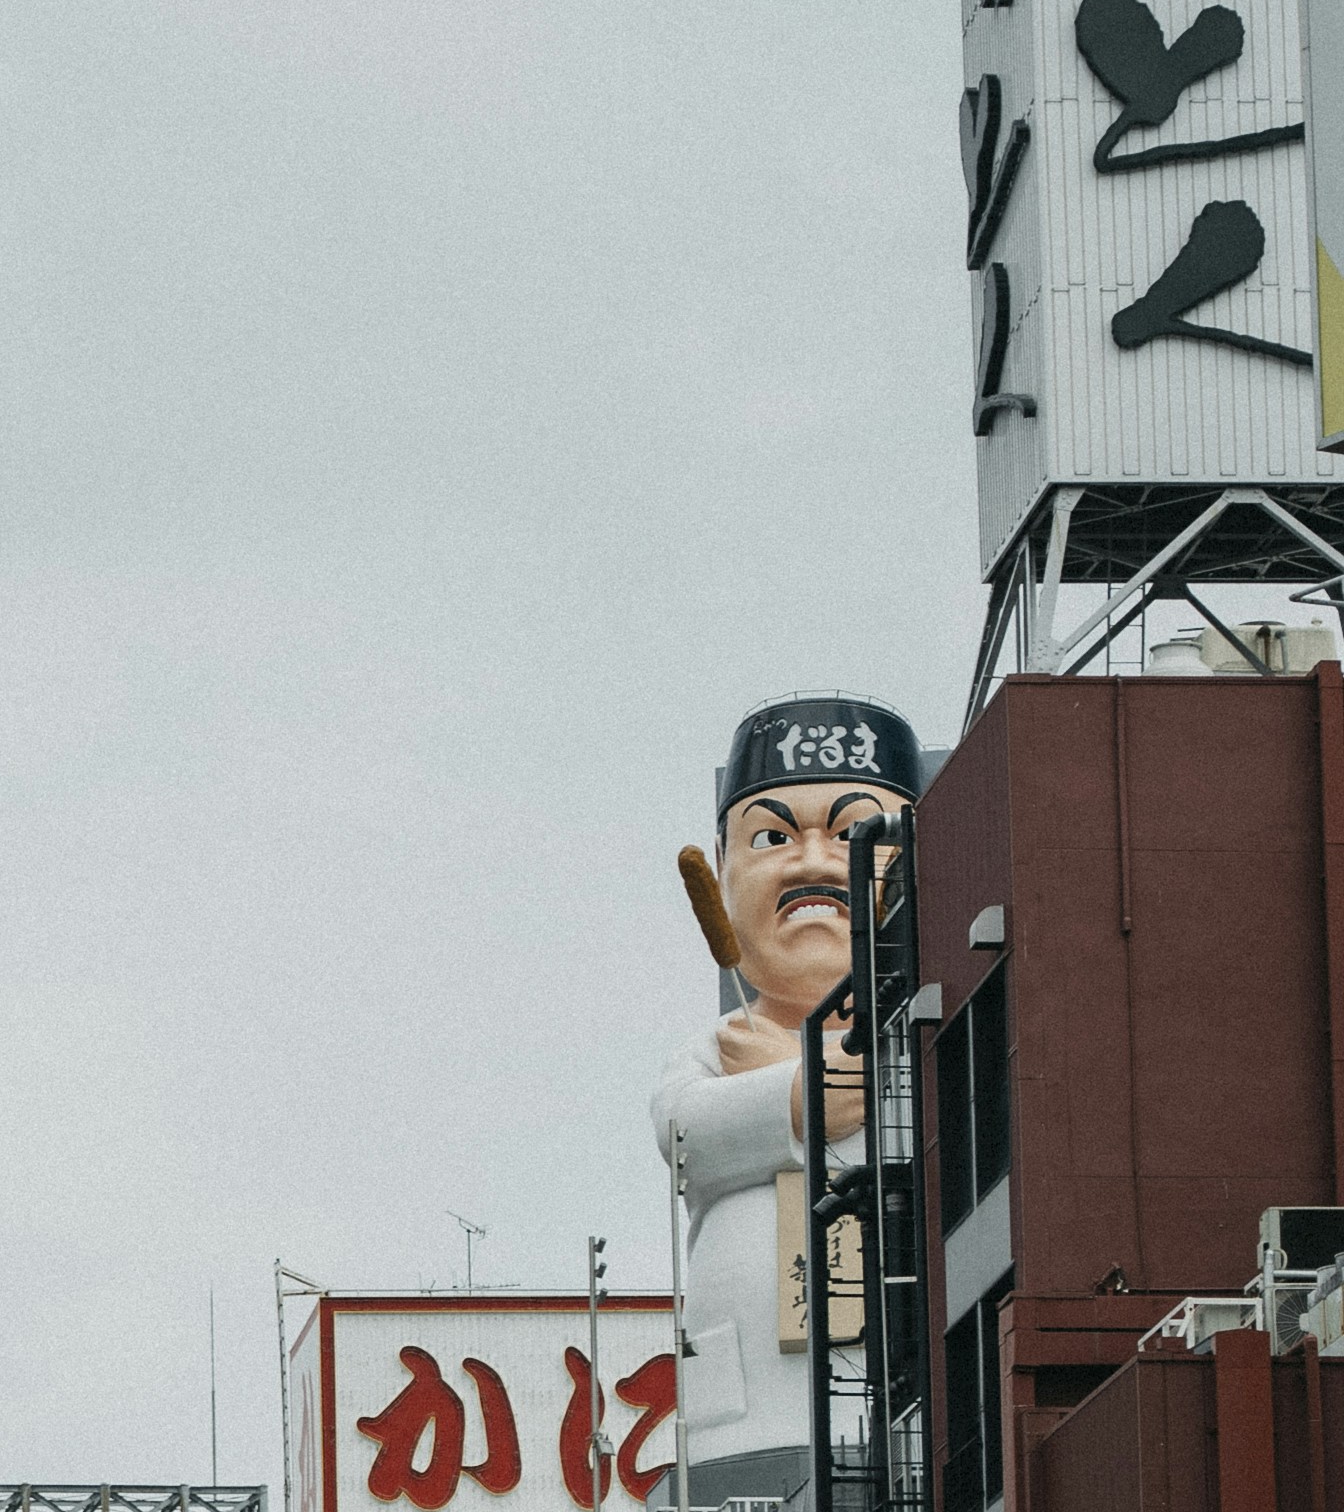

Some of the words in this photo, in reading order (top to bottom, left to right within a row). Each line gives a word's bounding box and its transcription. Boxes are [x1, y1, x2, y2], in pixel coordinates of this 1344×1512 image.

[777, 721, 881, 774] だるま
[355, 1344, 677, 1512] かに
